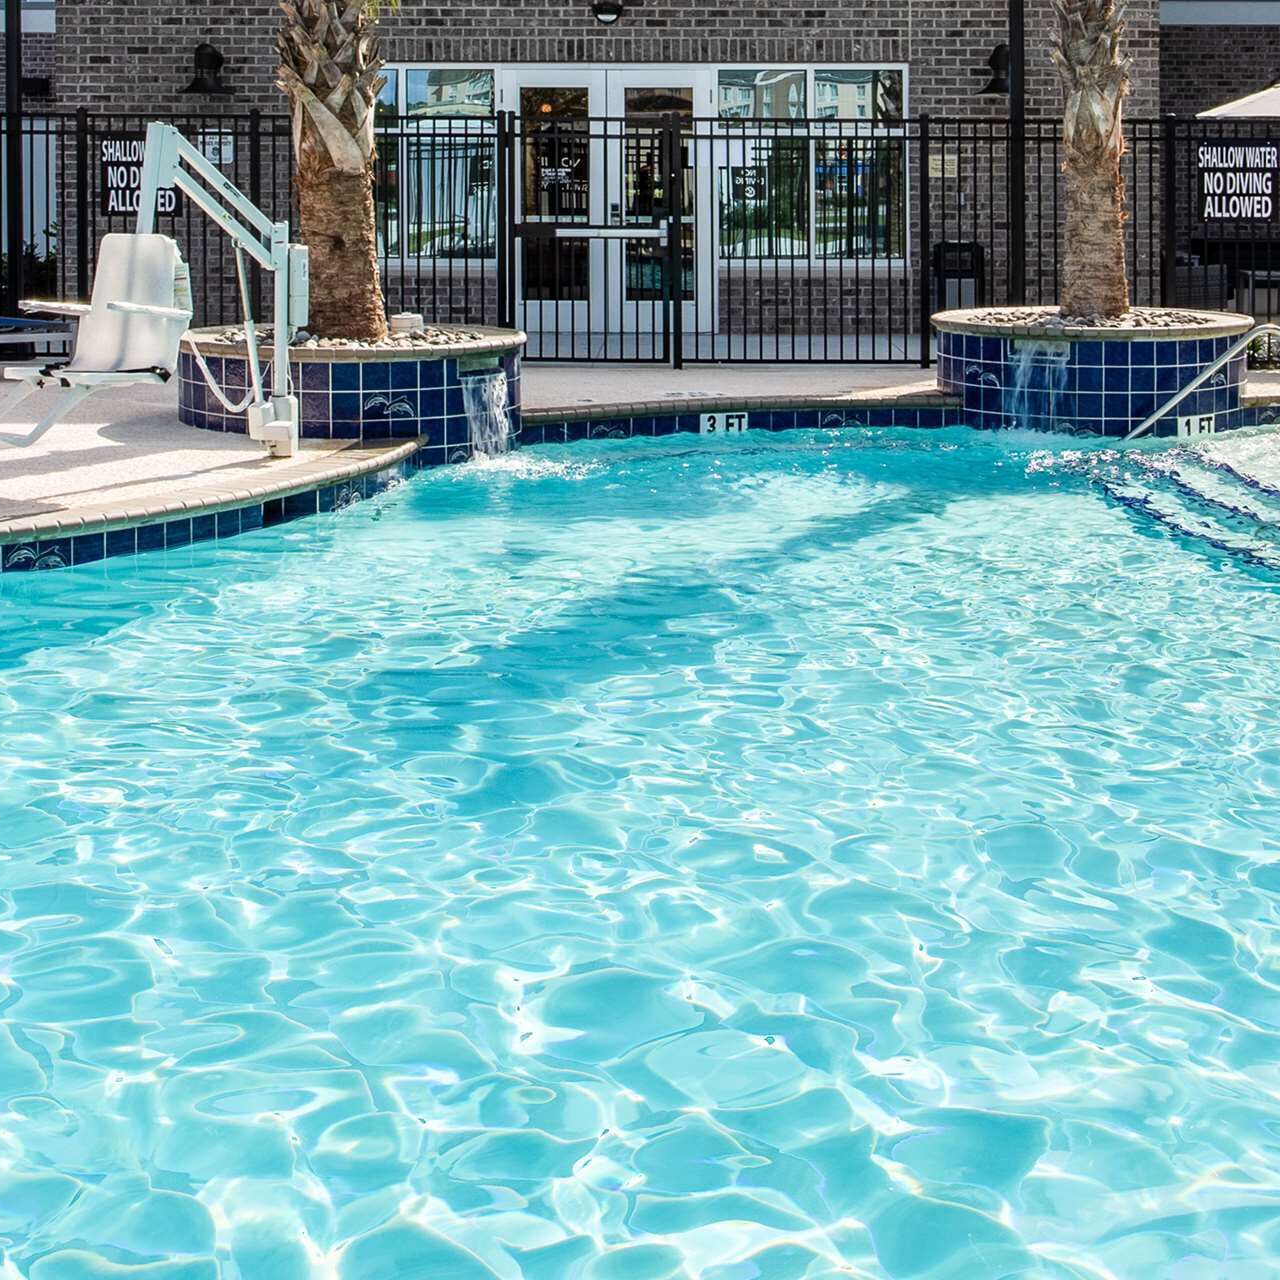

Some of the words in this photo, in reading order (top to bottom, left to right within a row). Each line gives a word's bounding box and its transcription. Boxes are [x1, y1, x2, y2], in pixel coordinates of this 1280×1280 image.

[1198, 146, 1245, 168] SHALLOW
[1245, 146, 1278, 168] WATER
[107, 166, 127, 188] NO
[1203, 172, 1224, 194] NO
[1226, 172, 1272, 194] DIVING
[107, 190, 176, 212] ALLOED
[1203, 195, 1272, 218] ALLOWED
[707, 415, 717, 433] 3
[725, 414, 746, 432] FT
[1184, 418, 1191, 436] 1
[1198, 416, 1213, 434] FT
